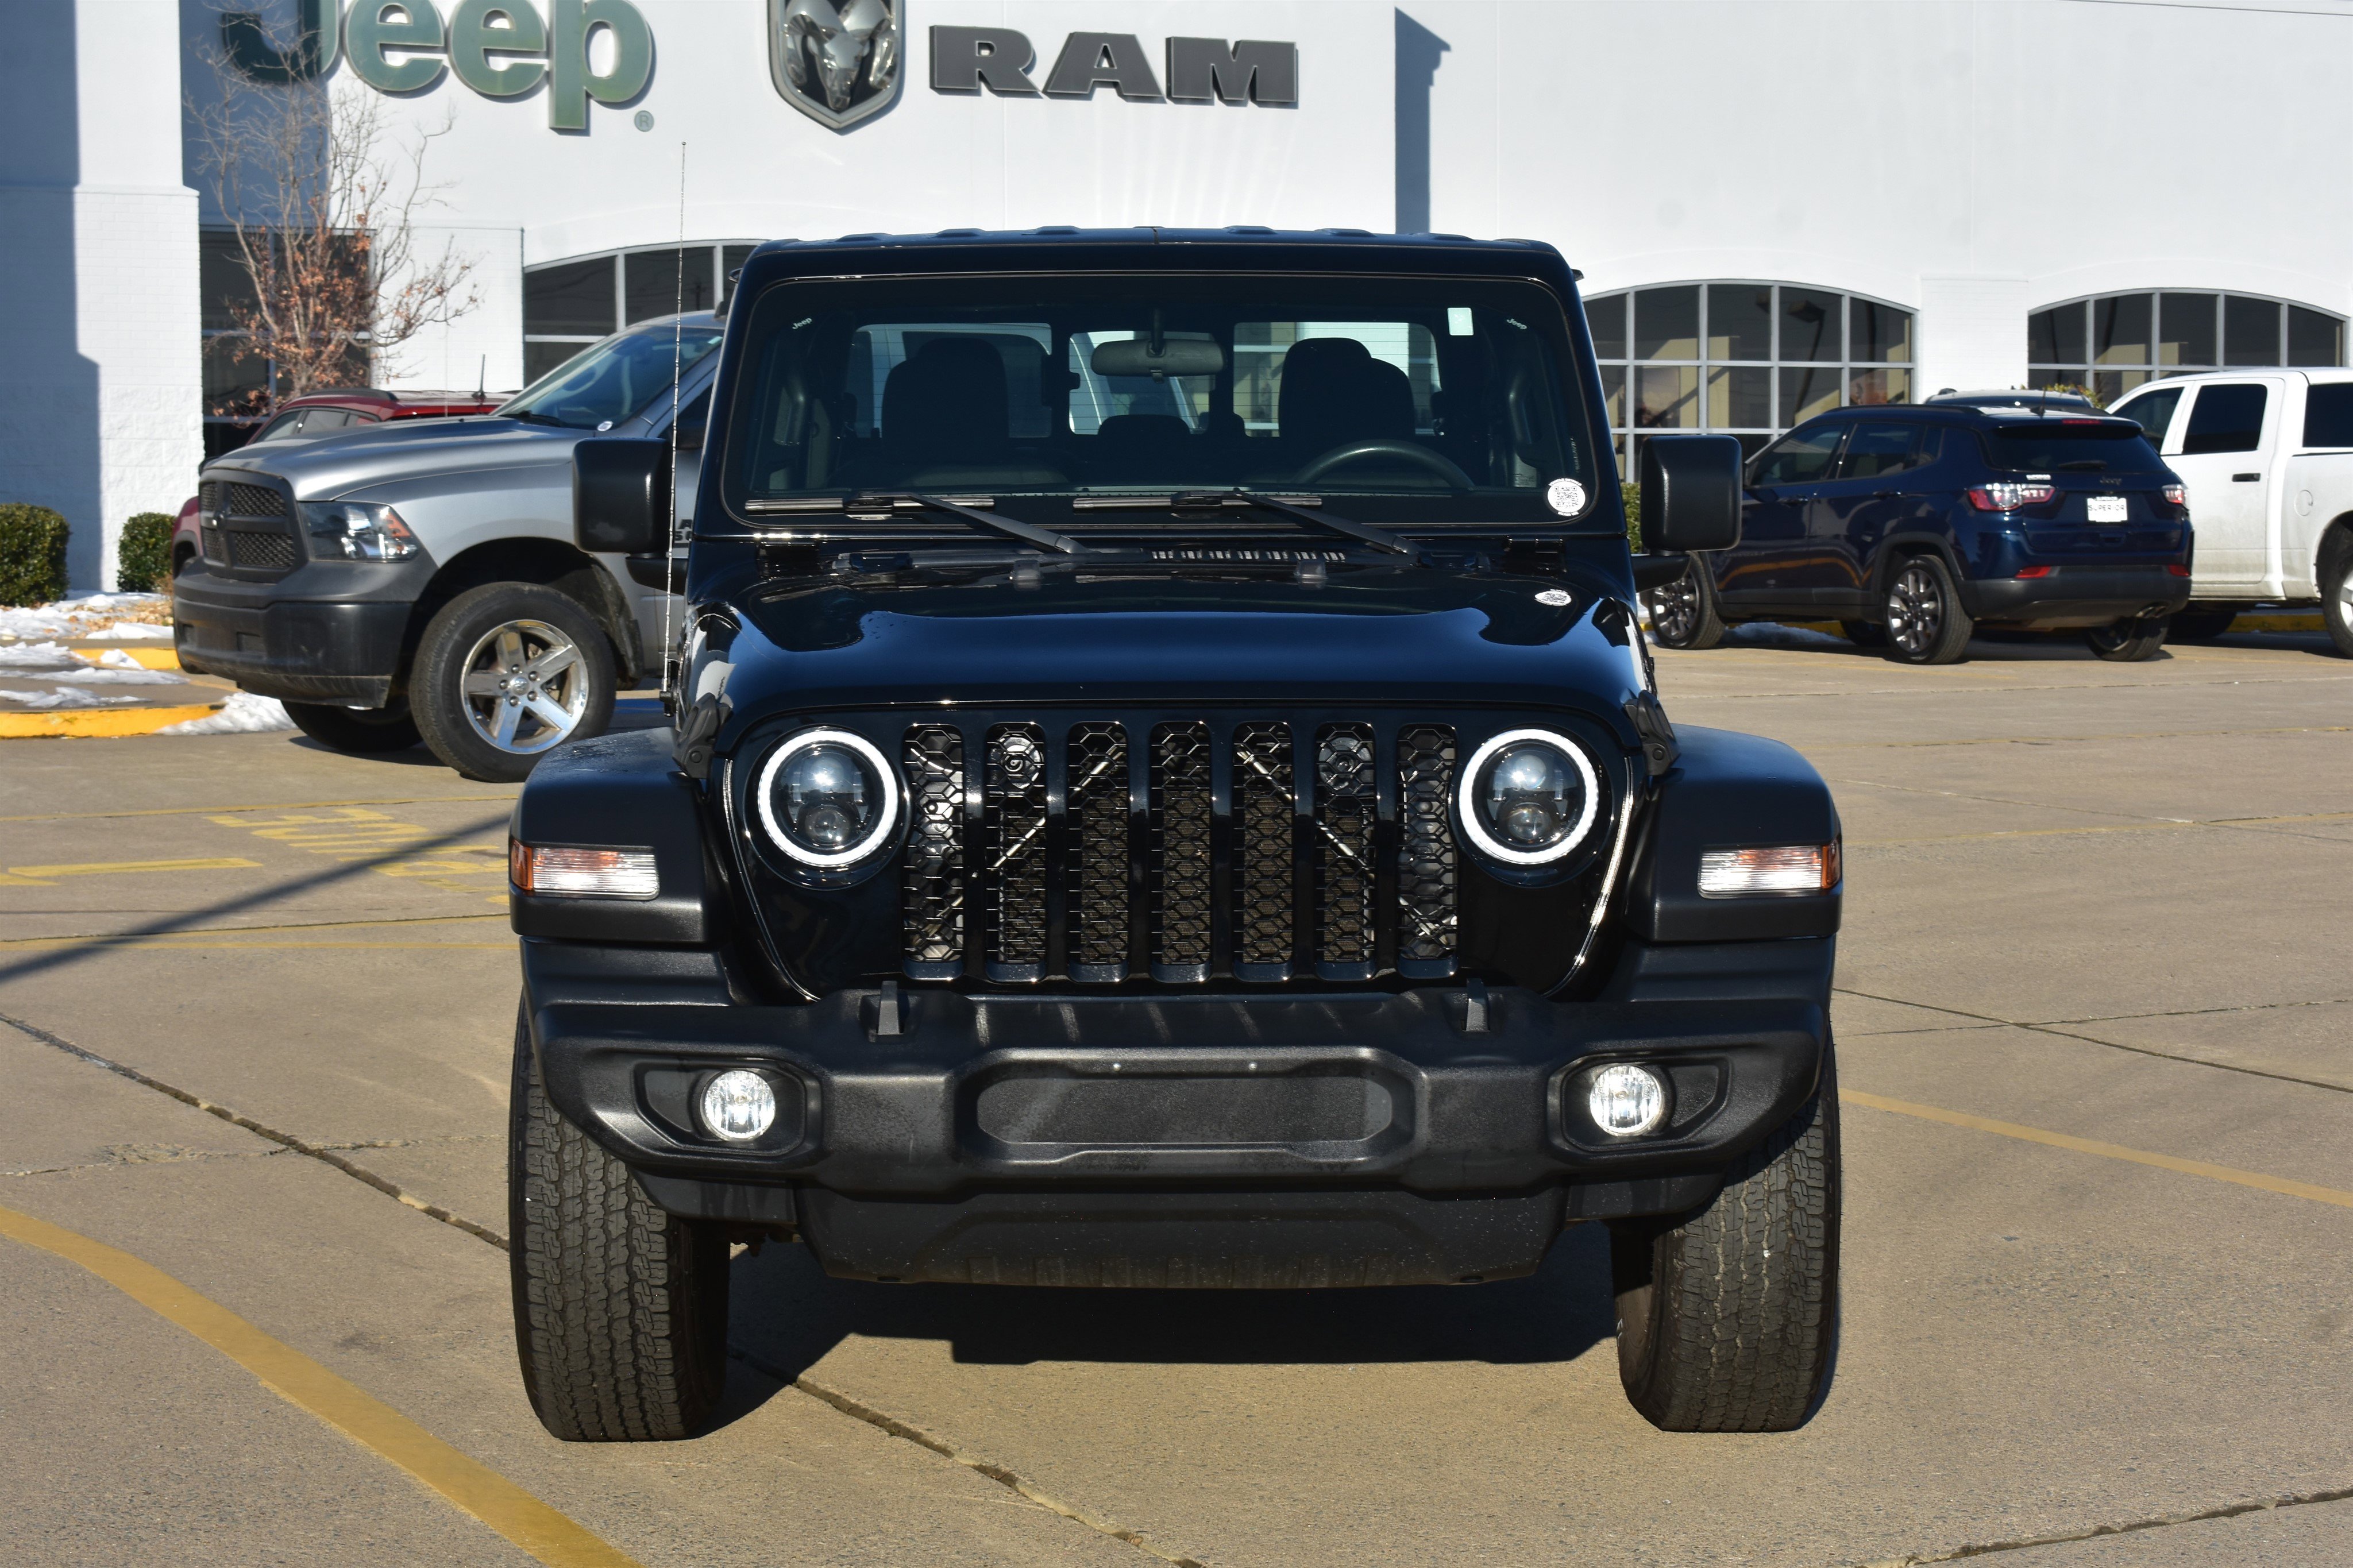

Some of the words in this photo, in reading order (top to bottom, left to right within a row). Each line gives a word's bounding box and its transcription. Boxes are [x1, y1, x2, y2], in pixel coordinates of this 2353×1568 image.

[222, 0, 654, 129] Jeep
[929, 25, 1297, 103] RAM
[792, 318, 812, 330] Jeep
[1506, 318, 1527, 330] Jeep
[203, 808, 509, 906] RVICE
